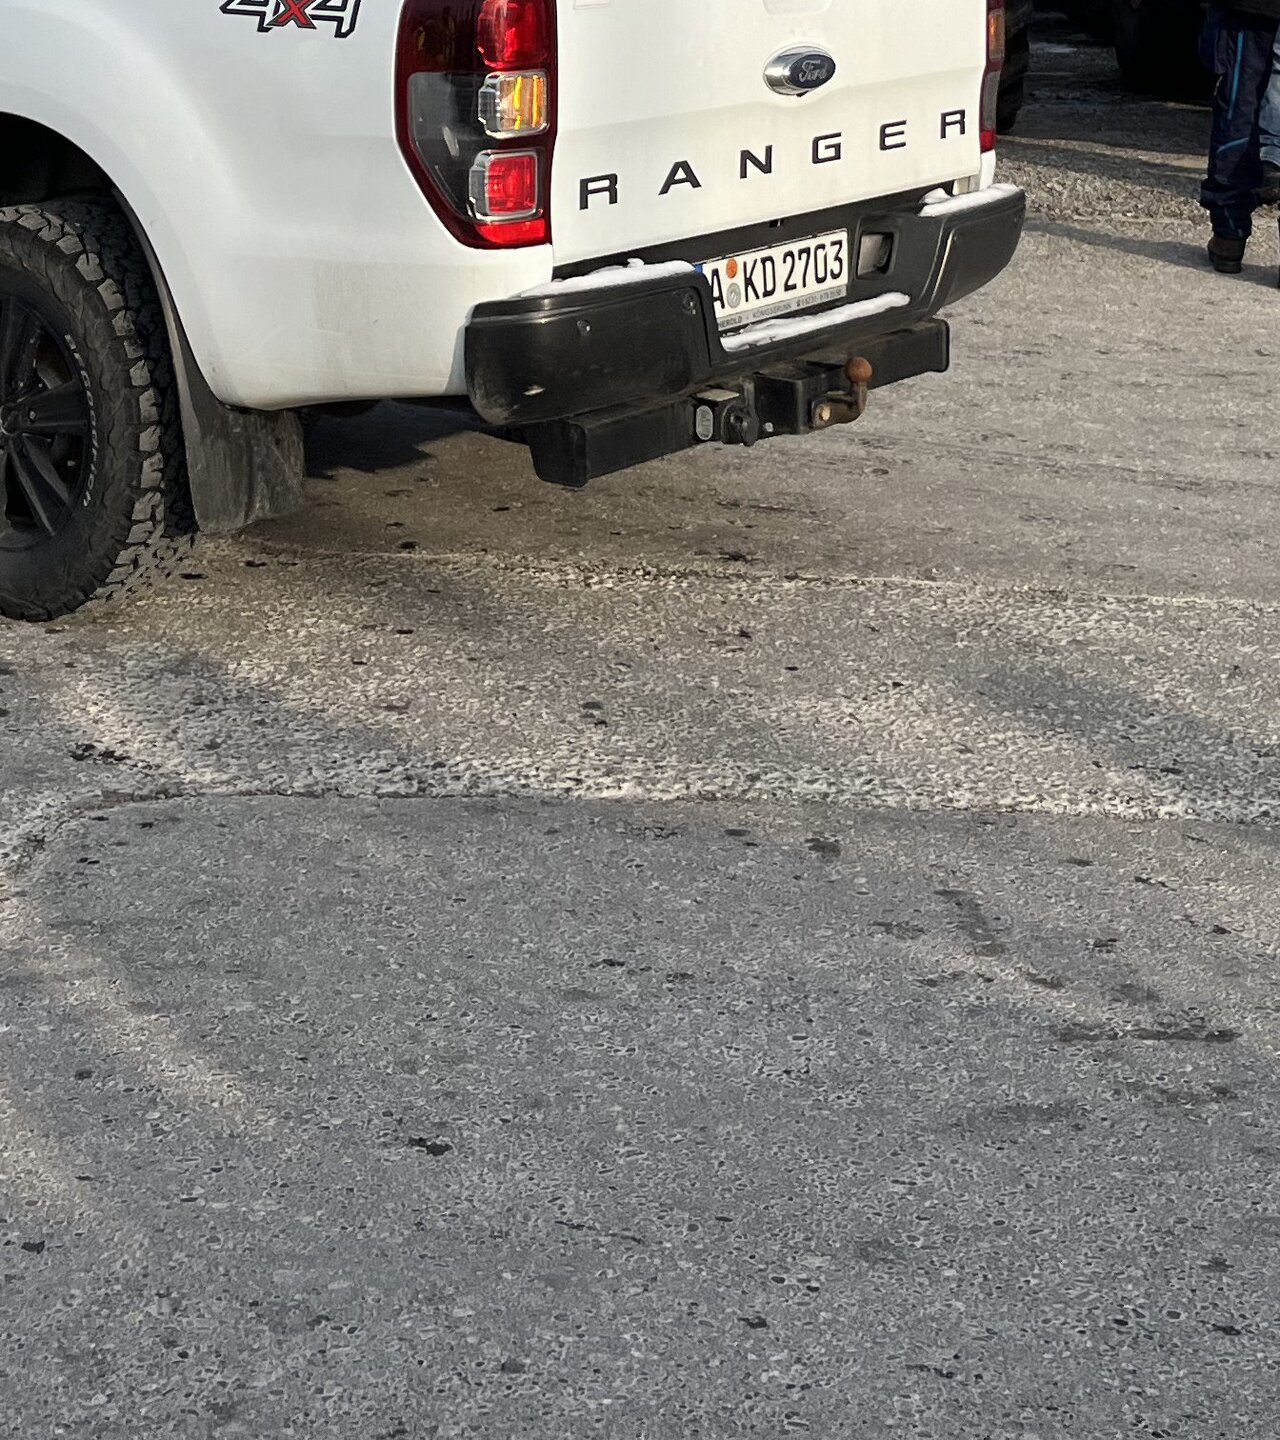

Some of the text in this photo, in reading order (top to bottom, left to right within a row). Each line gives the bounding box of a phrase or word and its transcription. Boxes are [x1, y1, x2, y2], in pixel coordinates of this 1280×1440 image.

[798, 59, 828, 83] Ford
[579, 108, 967, 211] RANGER
[711, 239, 843, 310] A KD 2703
